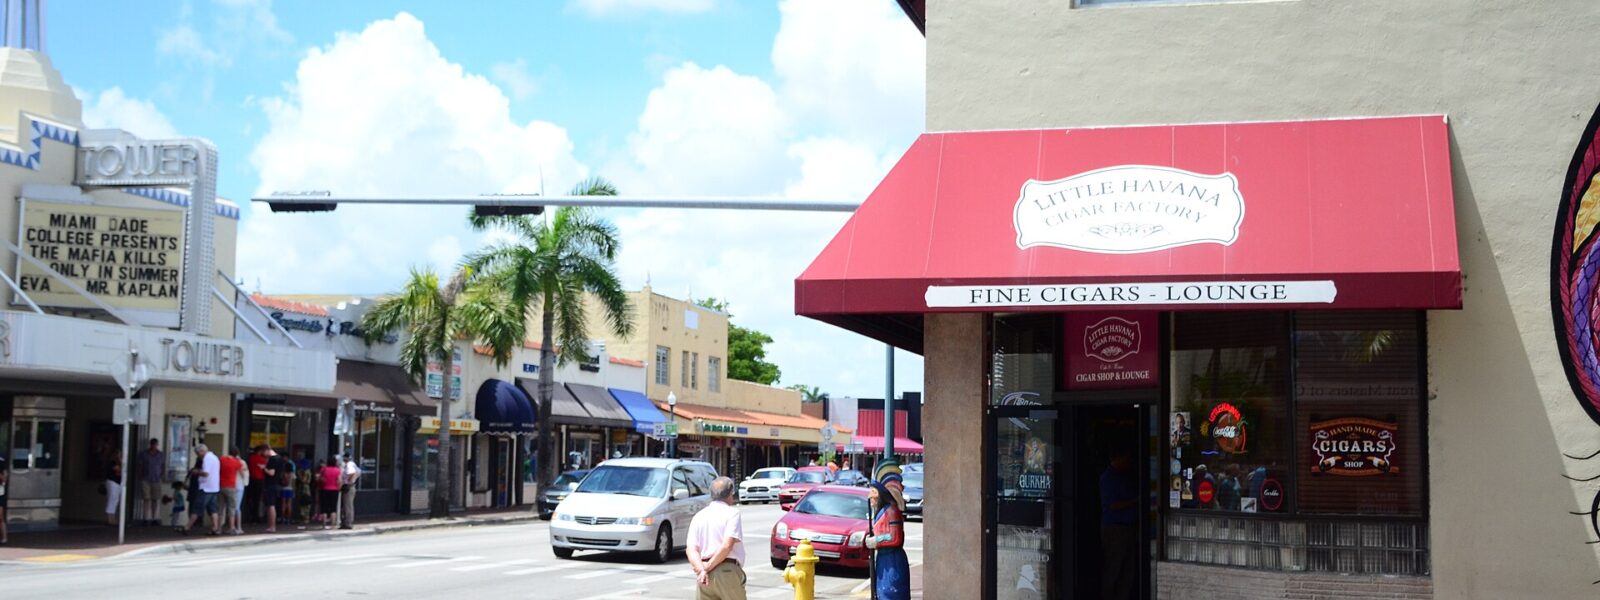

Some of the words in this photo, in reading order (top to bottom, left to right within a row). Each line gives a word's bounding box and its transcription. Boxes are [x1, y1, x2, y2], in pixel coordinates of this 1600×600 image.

[80, 143, 198, 177] TOWER
[1034, 181, 1114, 211] LITTLE
[1122, 180, 1220, 207] HAVANA
[50, 213, 96, 230] MIAMI
[1045, 203, 1104, 227] CIGAR
[1114, 201, 1207, 224] FACTORY
[26, 228, 94, 246] COLLEGE
[100, 233, 178, 250] PRESENTS
[30, 245, 59, 260] THE
[68, 249, 116, 264] MAFIA
[124, 251, 167, 266] KILLS
[50, 263, 89, 277] ONLY
[99, 265, 113, 279] IN
[119, 267, 179, 282] SUMMER
[20, 276, 50, 292] EVA
[118, 283, 179, 298] KAPLAN
[969, 288, 1032, 304] FINE
[1040, 286, 1140, 303] CIGARS
[1165, 284, 1288, 301] LOUNGE
[1088, 325, 1109, 343] LITTLE
[1110, 324, 1135, 340] HAVANA
[1091, 337, 1107, 350] CIGAR
[1108, 335, 1132, 348] FACTORY
[160, 338, 244, 377] TOWER
[1076, 373, 1097, 382] CIGAR
[1097, 372, 1115, 381] SHOP
[1115, 372, 1120, 380] &
[1122, 370, 1150, 379] LOUNGE
[1329, 426, 1353, 436] HAND
[1354, 426, 1377, 436] MADE
[1320, 440, 1387, 453] CIGARS
[1019, 474, 1051, 489] GURKHA
